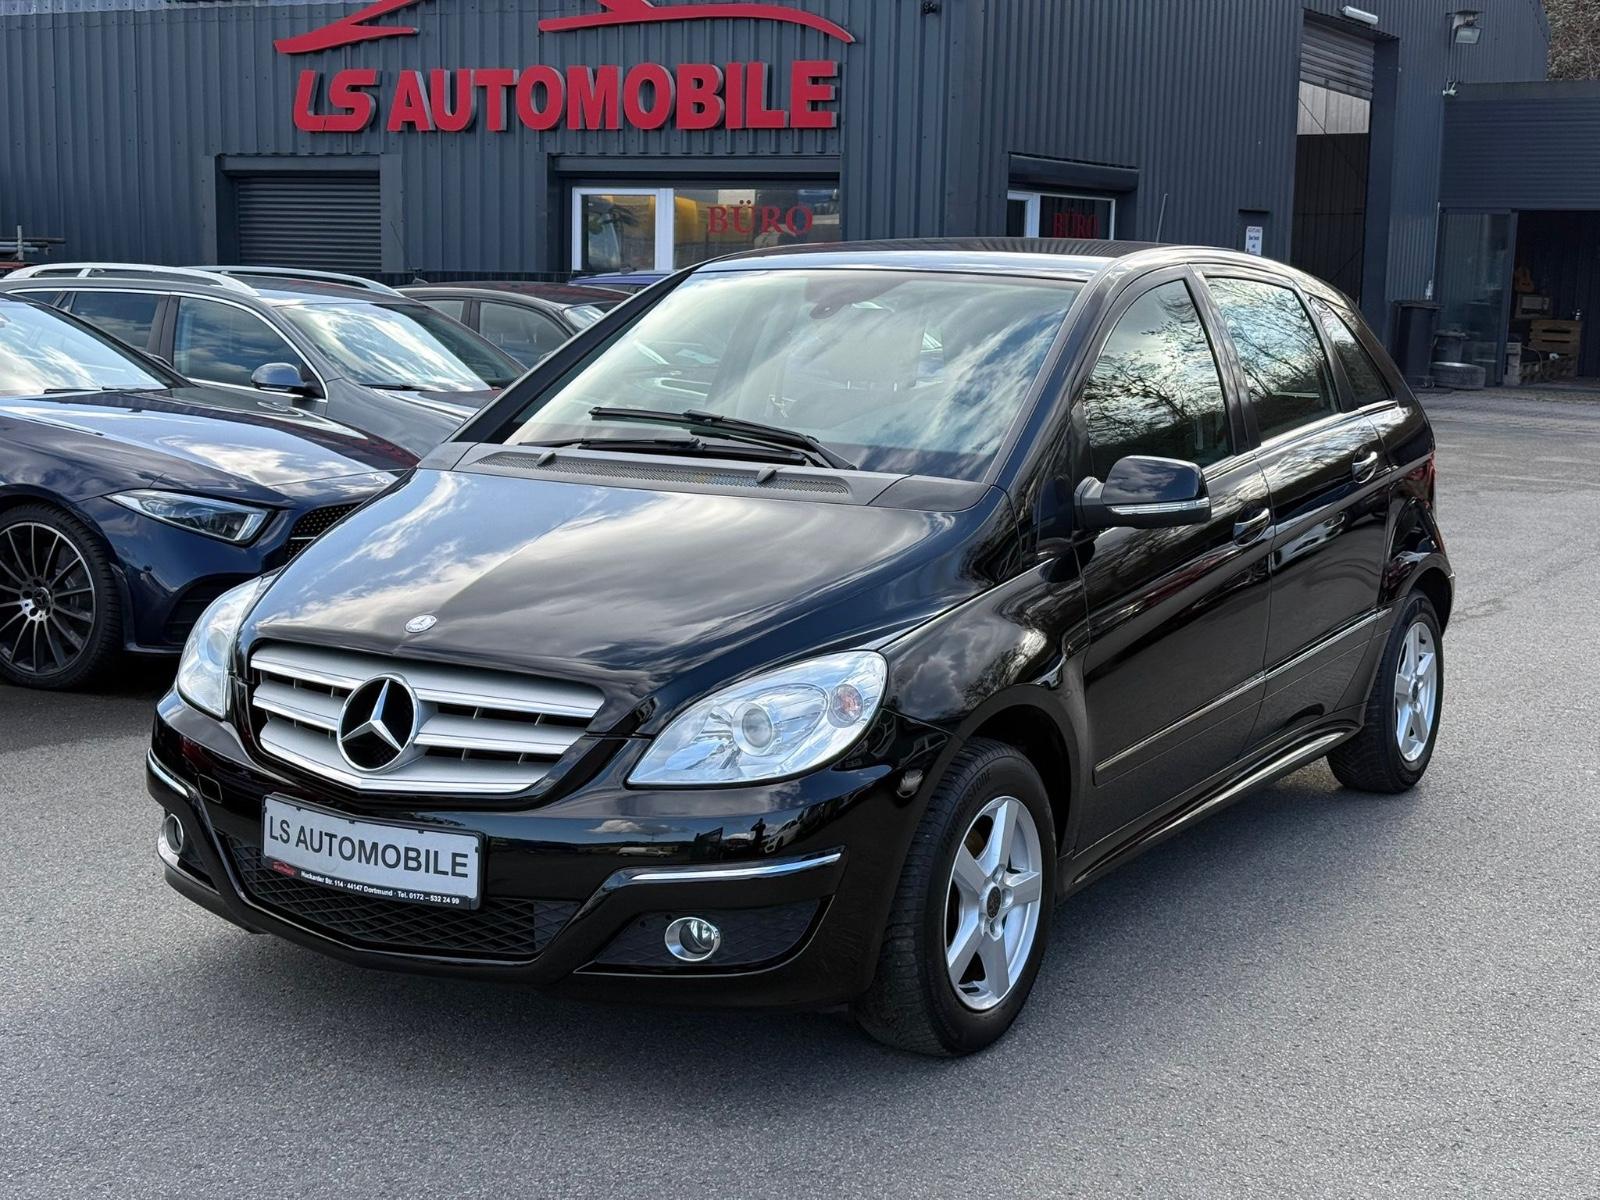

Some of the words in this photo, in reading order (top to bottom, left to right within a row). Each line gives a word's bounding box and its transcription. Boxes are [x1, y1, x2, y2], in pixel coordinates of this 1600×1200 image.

[293, 69, 376, 132] LS
[387, 60, 838, 132] AUTOMOBILE
[707, 199, 813, 236] BÜRO
[269, 815, 290, 844] LS
[295, 825, 469, 878] AUTOMOBILE
[325, 877, 334, 886] Str.
[334, 879, 344, 888] 114
[346, 882, 363, 891] 44147
[363, 885, 393, 897] Dortmund
[397, 890, 408, 899] Tel.
[408, 892, 424, 901] 0172
[430, 895, 442, 903] 532
[442, 896, 451, 904] 24
[451, 897, 460, 905] 99
